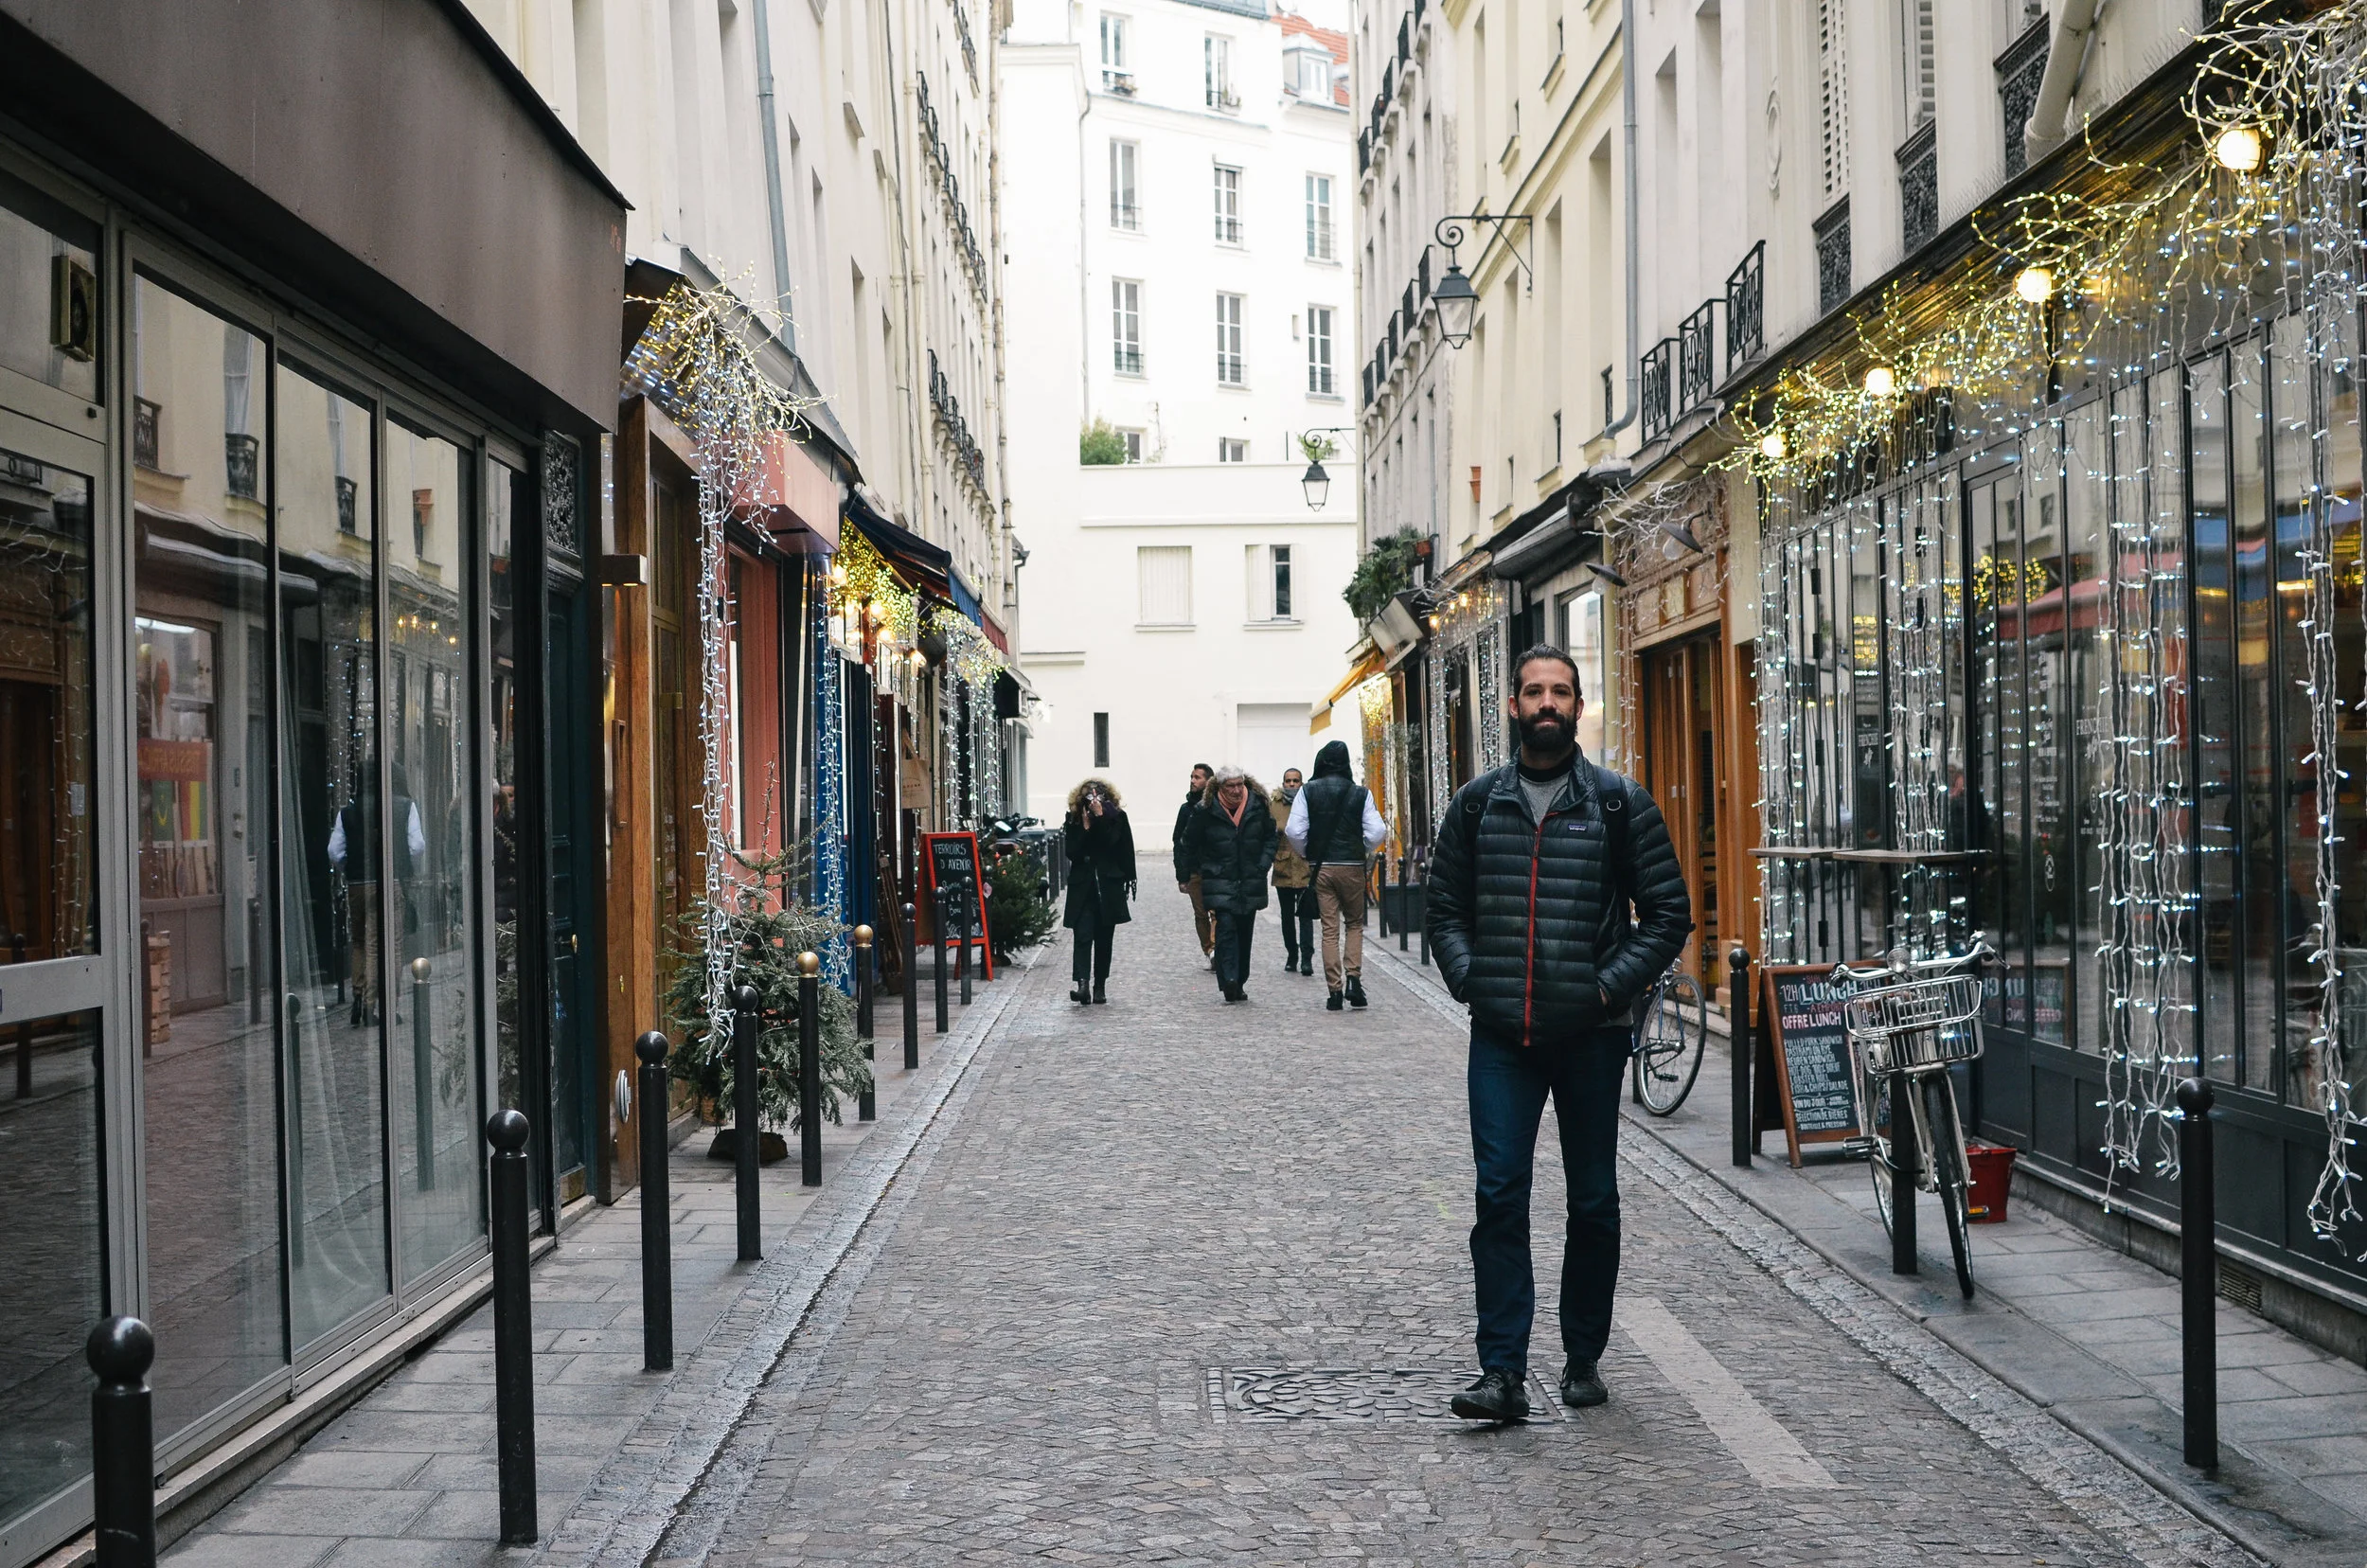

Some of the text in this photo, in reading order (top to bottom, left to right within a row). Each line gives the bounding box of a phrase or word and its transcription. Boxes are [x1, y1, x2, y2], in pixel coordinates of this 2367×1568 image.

[934, 842, 966, 856] TERROIRS
[948, 858, 971, 871] AVENIR
[1781, 985, 1798, 1002] 12H
[1798, 981, 1858, 1005] LUNCH
[1782, 1011, 1842, 1030] OFFRE LUNCH
